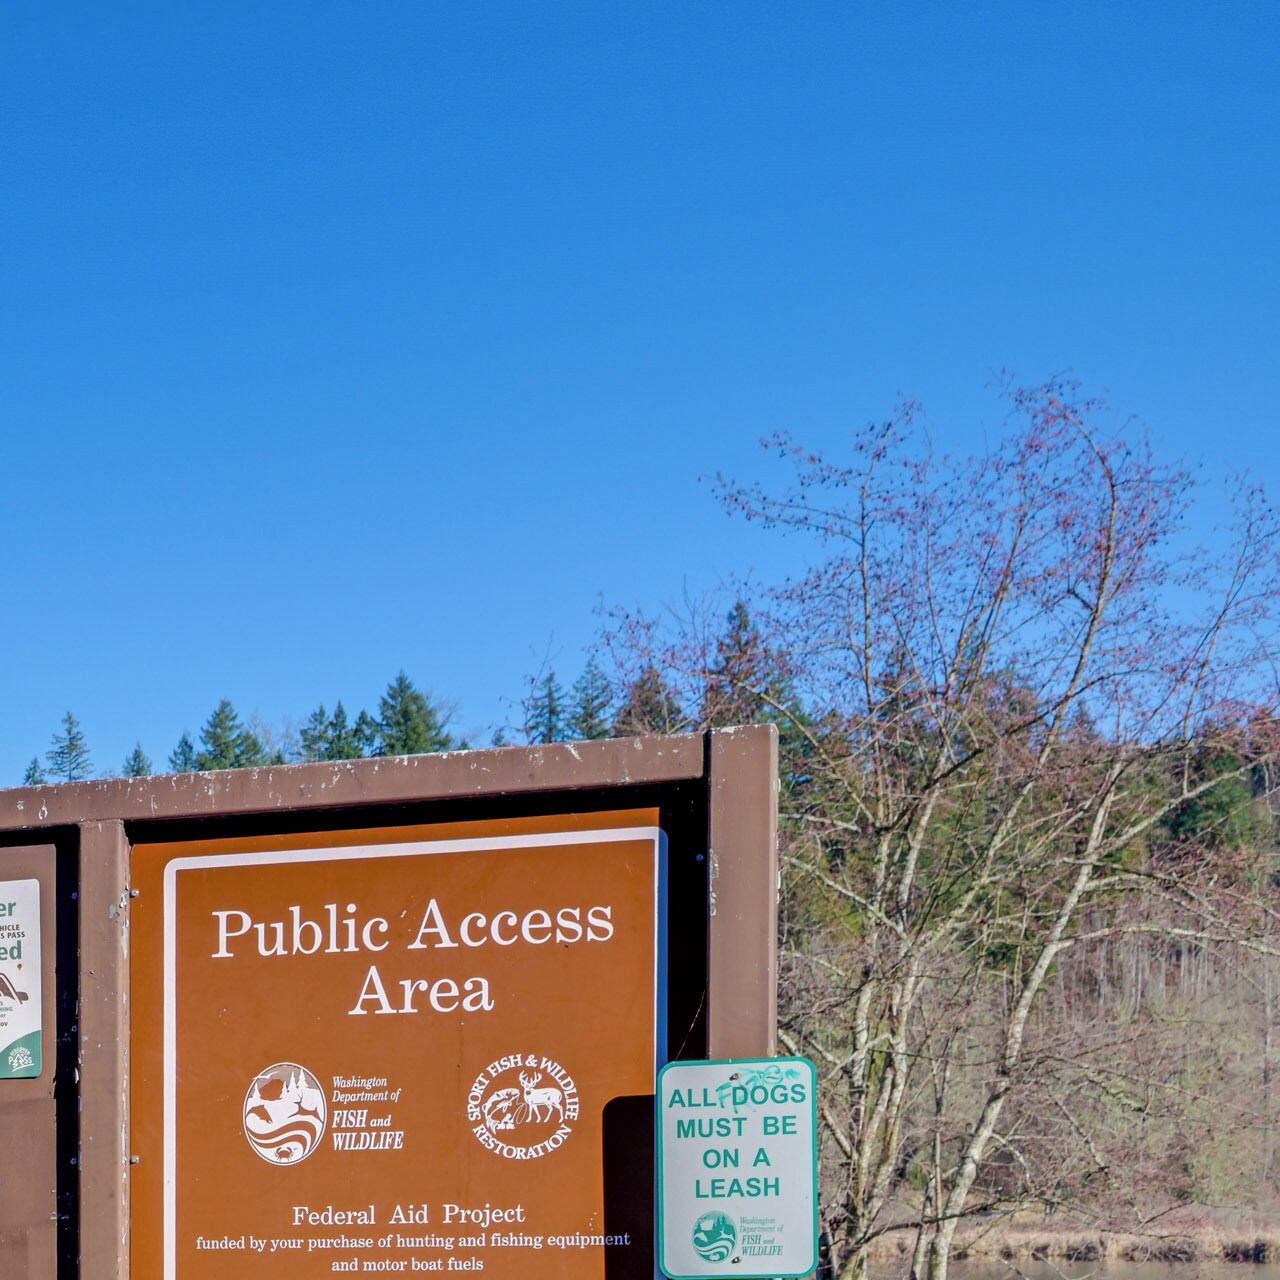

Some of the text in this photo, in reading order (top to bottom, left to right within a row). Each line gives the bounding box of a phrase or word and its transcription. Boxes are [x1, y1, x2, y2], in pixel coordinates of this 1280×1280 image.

[7, 931, 26, 939] PASS
[212, 898, 615, 958] Public Access
[348, 965, 495, 1015] Area
[333, 1076, 387, 1090] Washington
[467, 1054, 579, 1121] SPORT FISH & WILDLIFE
[332, 1088, 402, 1104] Department of
[668, 1083, 806, 1108] ALL DOGS
[332, 1109, 392, 1128] FISH and
[676, 1115, 797, 1138] MUST BE
[333, 1131, 404, 1151] WILDLIFE
[472, 1123, 572, 1160] RESTORATION
[703, 1147, 771, 1169] ON A
[696, 1177, 780, 1198] LEASH
[292, 1203, 526, 1228] Federal Aid Project
[195, 1231, 631, 1252] funded by your purchase of hunting and fishing equipment
[742, 1235, 761, 1244] FISH
[742, 1246, 784, 1256] WILDLIFE
[331, 1257, 484, 1271] and motor boat fuels
